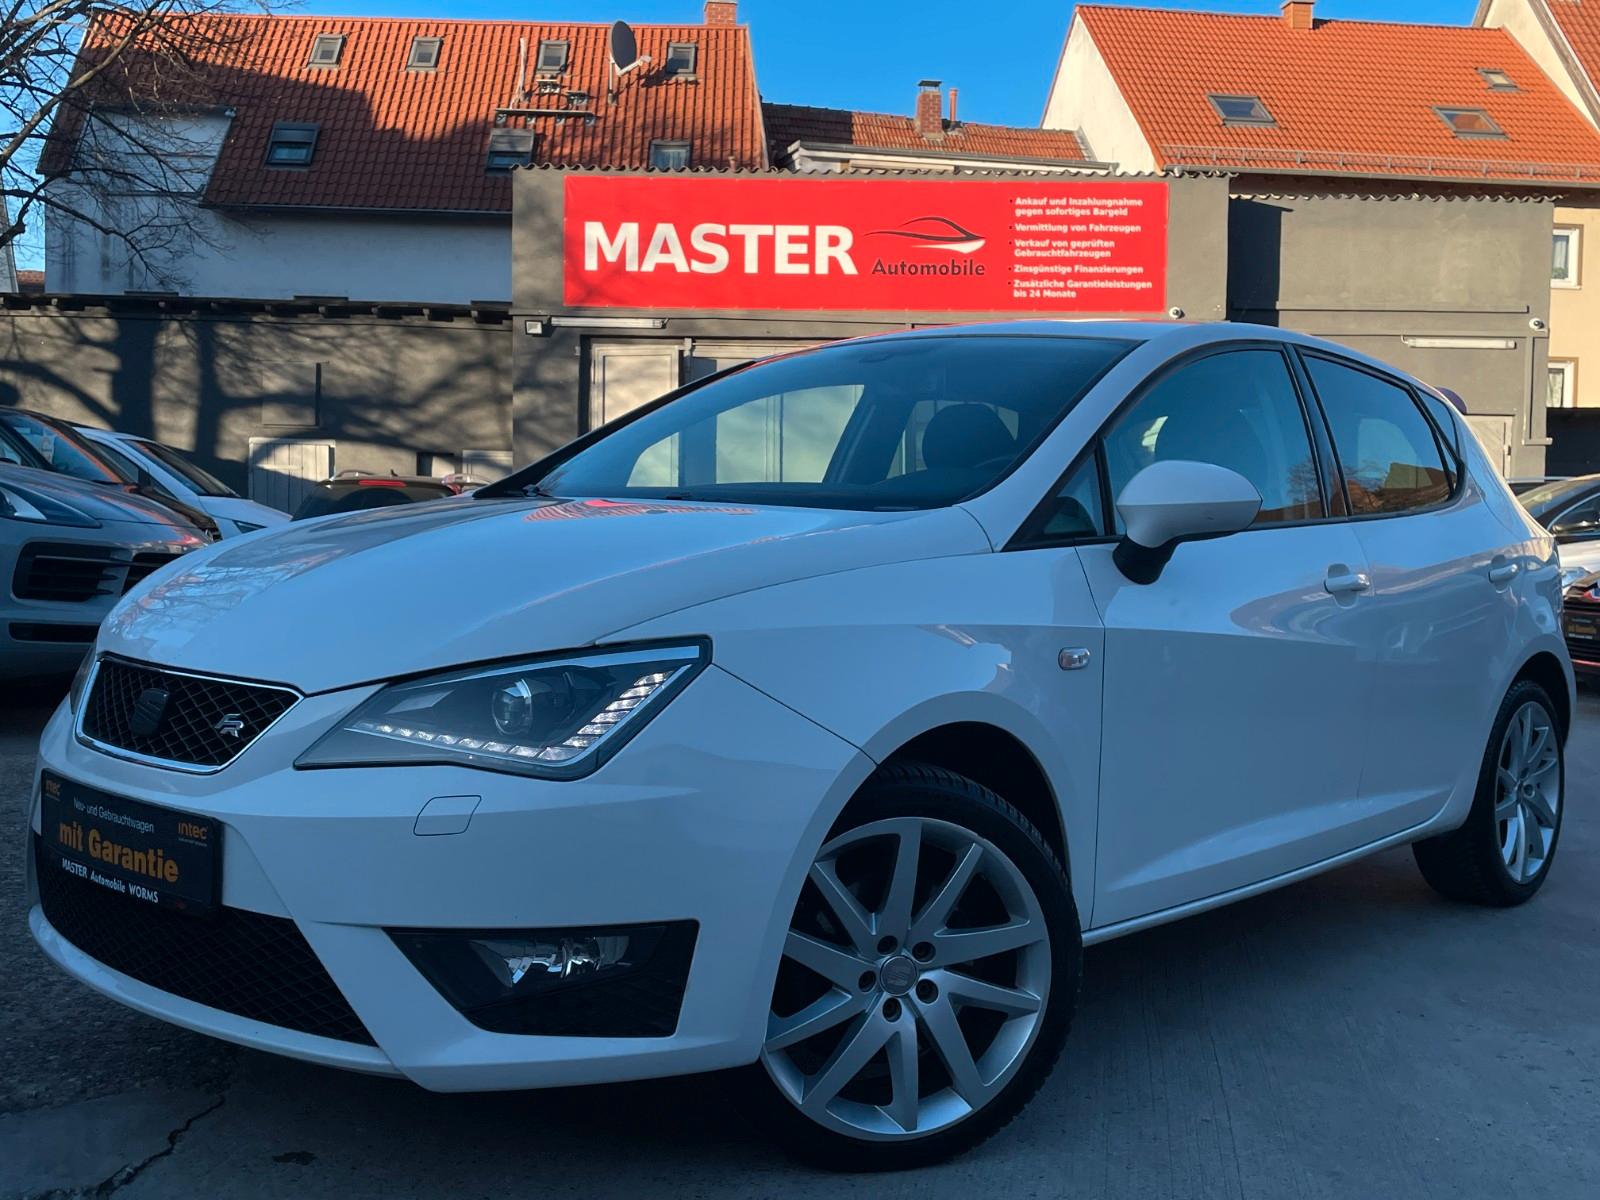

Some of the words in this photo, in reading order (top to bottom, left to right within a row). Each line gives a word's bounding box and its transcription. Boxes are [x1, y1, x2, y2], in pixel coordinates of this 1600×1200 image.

[1015, 197, 1047, 206] Ankauf
[1050, 198, 1066, 206] und
[1069, 198, 1143, 208] Inzahlungnahme
[1015, 208, 1043, 217] gegen
[1045, 207, 1091, 217] sofortiges
[1093, 208, 1128, 217] Bargeld
[1015, 224, 1068, 234] Vermittlung
[1089, 224, 1141, 234] Fahrzeugen
[584, 221, 859, 275] MASTER
[1014, 239, 1050, 247] Verkauf
[1070, 239, 1115, 249] geprüften
[1014, 249, 1111, 259] Gebrauchtfahrzeugen
[871, 258, 985, 276] Automobile
[1014, 264, 1072, 275] Zinsgünstige
[1074, 265, 1144, 275] Finanzierungen
[1013, 279, 1065, 288] Zusätzliche
[1067, 280, 1153, 290] Garantieleistungen
[1013, 289, 1027, 297] bis
[1029, 289, 1040, 297] 24
[1043, 290, 1077, 298] Monate
[87, 804, 98, 817] und
[98, 806, 155, 834] Gebrauchtwagen
[59, 821, 84, 852] mit
[88, 828, 180, 883] Garantie
[62, 858, 88, 879] MASTER
[90, 870, 126, 893] Automobile
[128, 883, 159, 904] WORMS
